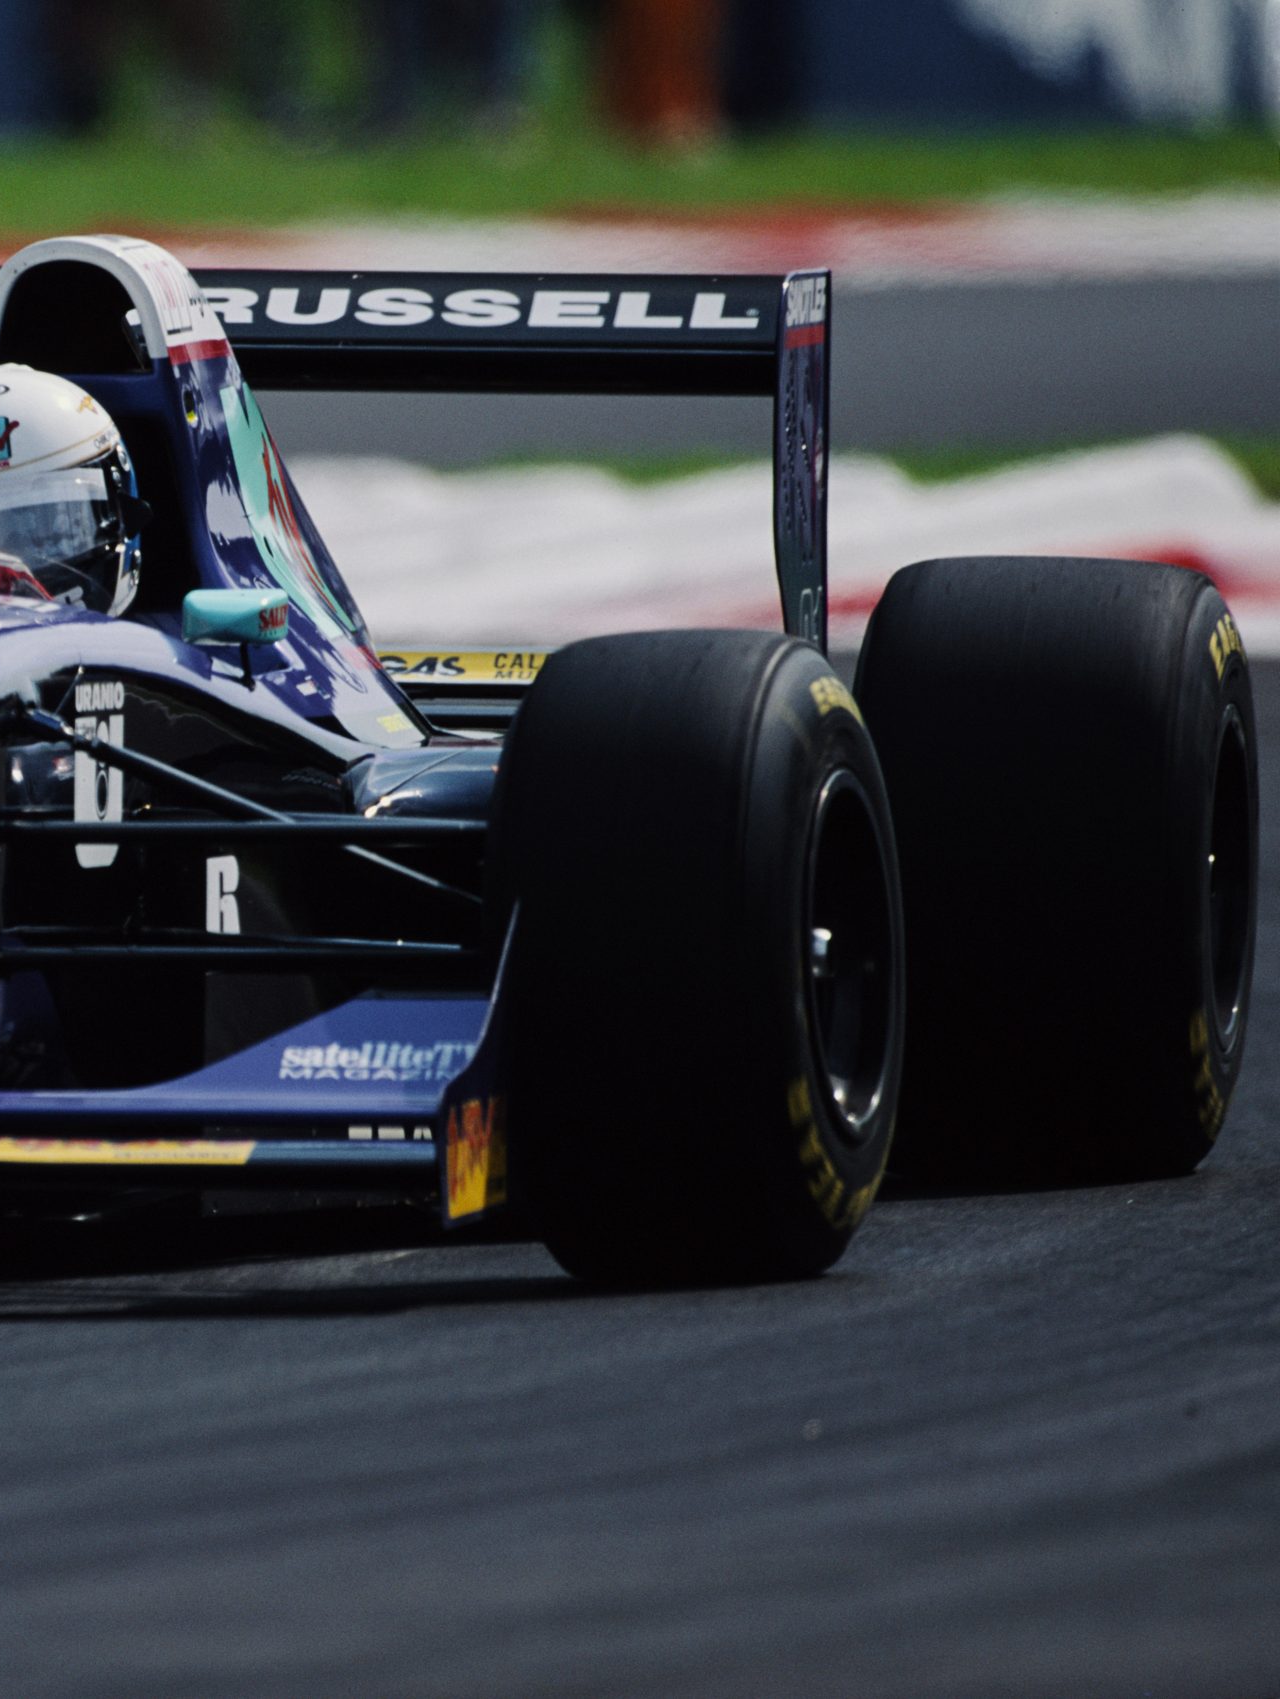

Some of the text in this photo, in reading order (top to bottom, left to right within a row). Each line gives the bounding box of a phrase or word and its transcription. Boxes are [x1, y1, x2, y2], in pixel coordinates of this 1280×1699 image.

[493, 653, 541, 669] CAL
[75, 682, 124, 712] URANIO
[279, 1067, 462, 1080] MAGAZIN
